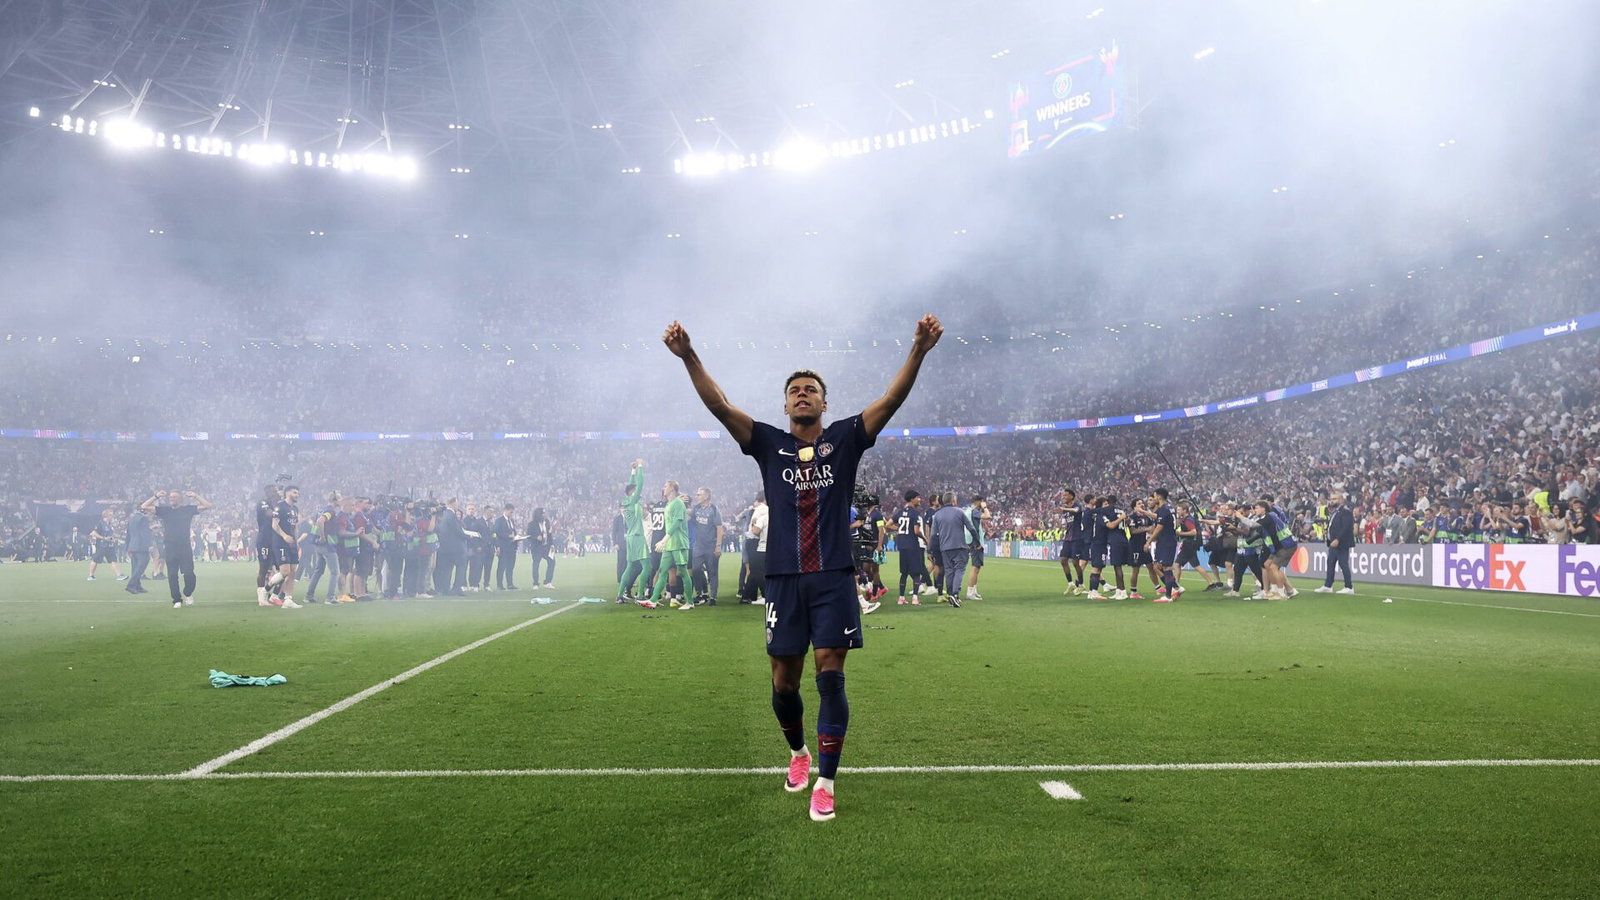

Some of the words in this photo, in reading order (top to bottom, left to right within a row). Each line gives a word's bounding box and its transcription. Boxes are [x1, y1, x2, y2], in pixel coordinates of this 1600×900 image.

[1036, 91, 1091, 122] WINNERS
[782, 464, 833, 485] QATAR
[795, 478, 834, 491] AIRWAYS
[652, 512, 664, 531] 29
[261, 547, 269, 555] 51
[1313, 547, 1424, 578] mtercard
[1444, 543, 1526, 590] FedEx
[1558, 544, 1600, 597] Fe
[765, 602, 778, 628] 14
